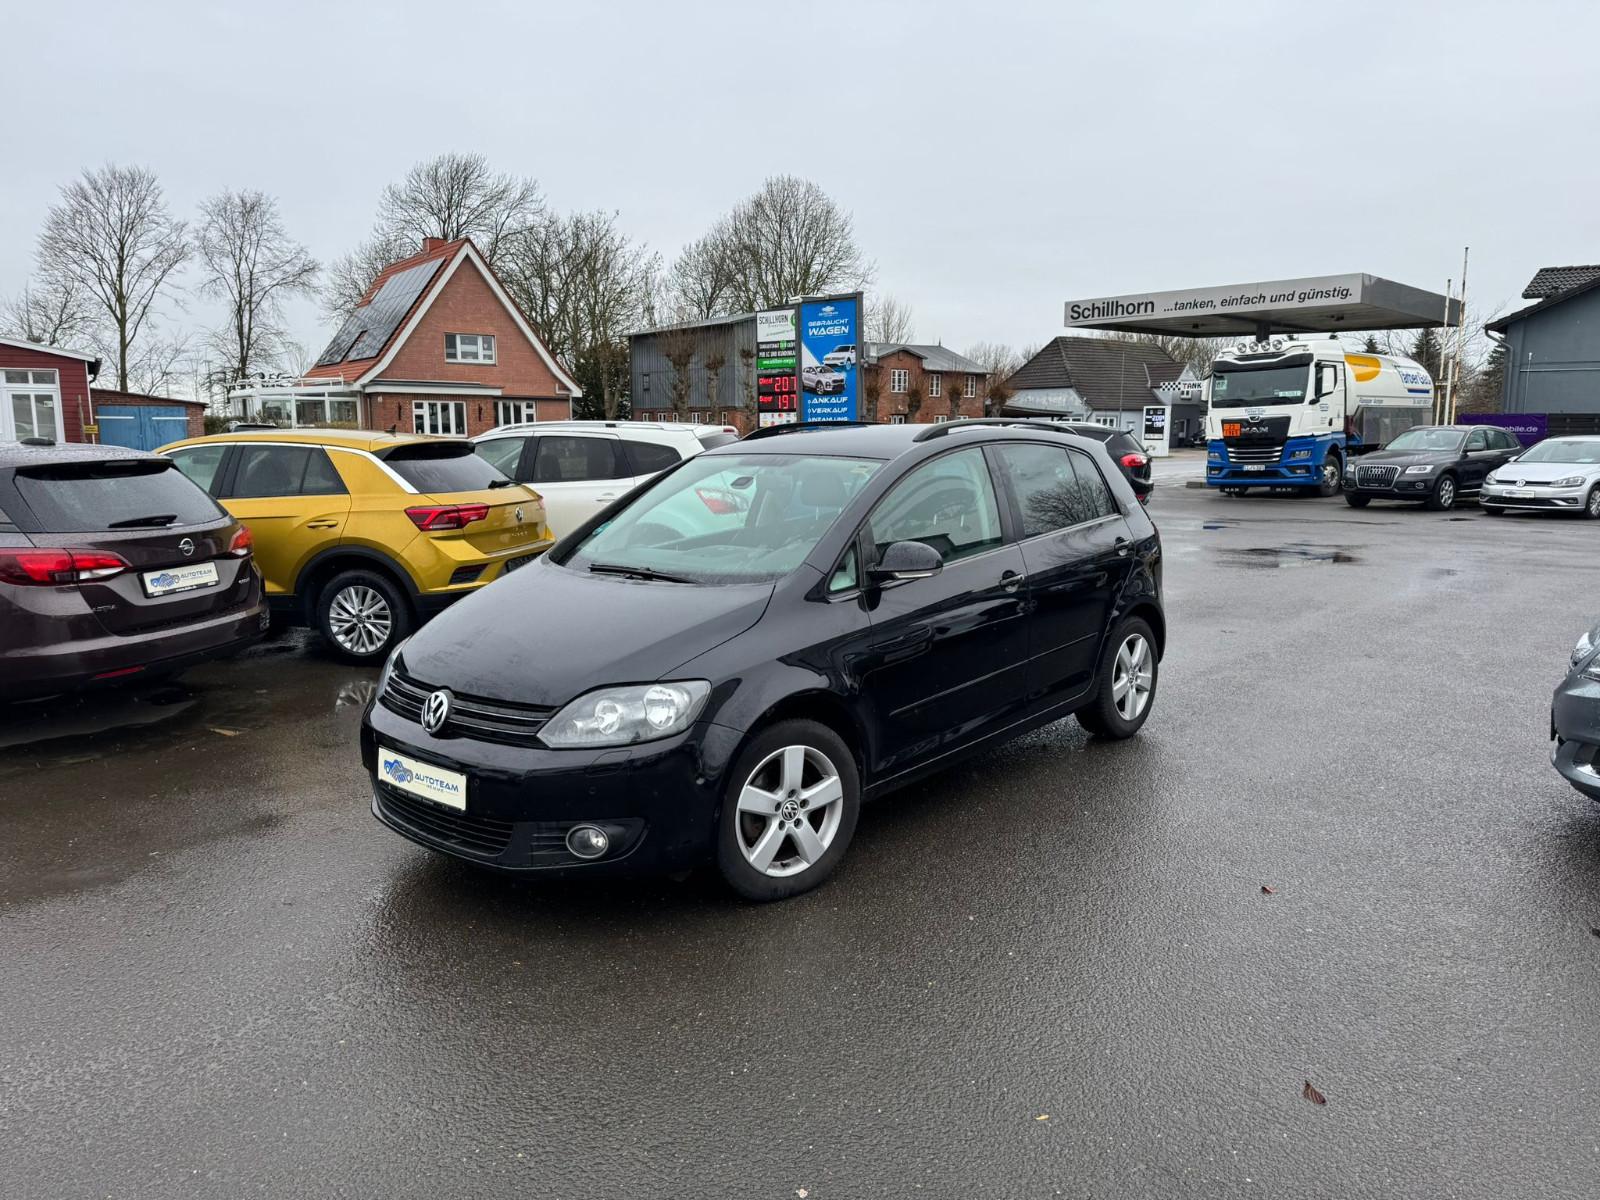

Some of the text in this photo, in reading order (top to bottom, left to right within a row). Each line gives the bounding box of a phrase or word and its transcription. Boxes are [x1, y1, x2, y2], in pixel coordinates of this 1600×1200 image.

[1070, 300, 1155, 320] Schillhorn
[1220, 293, 1266, 307] einfach
[1269, 290, 1296, 303] und
[1298, 286, 1353, 303] günstig.
[808, 318, 849, 327] GEBRAUCHT
[808, 325, 849, 336] WAGEN
[811, 396, 849, 404] ANKAUF
[181, 569, 213, 579] AUTOTEAM
[415, 773, 459, 792] AUTOTEAM
